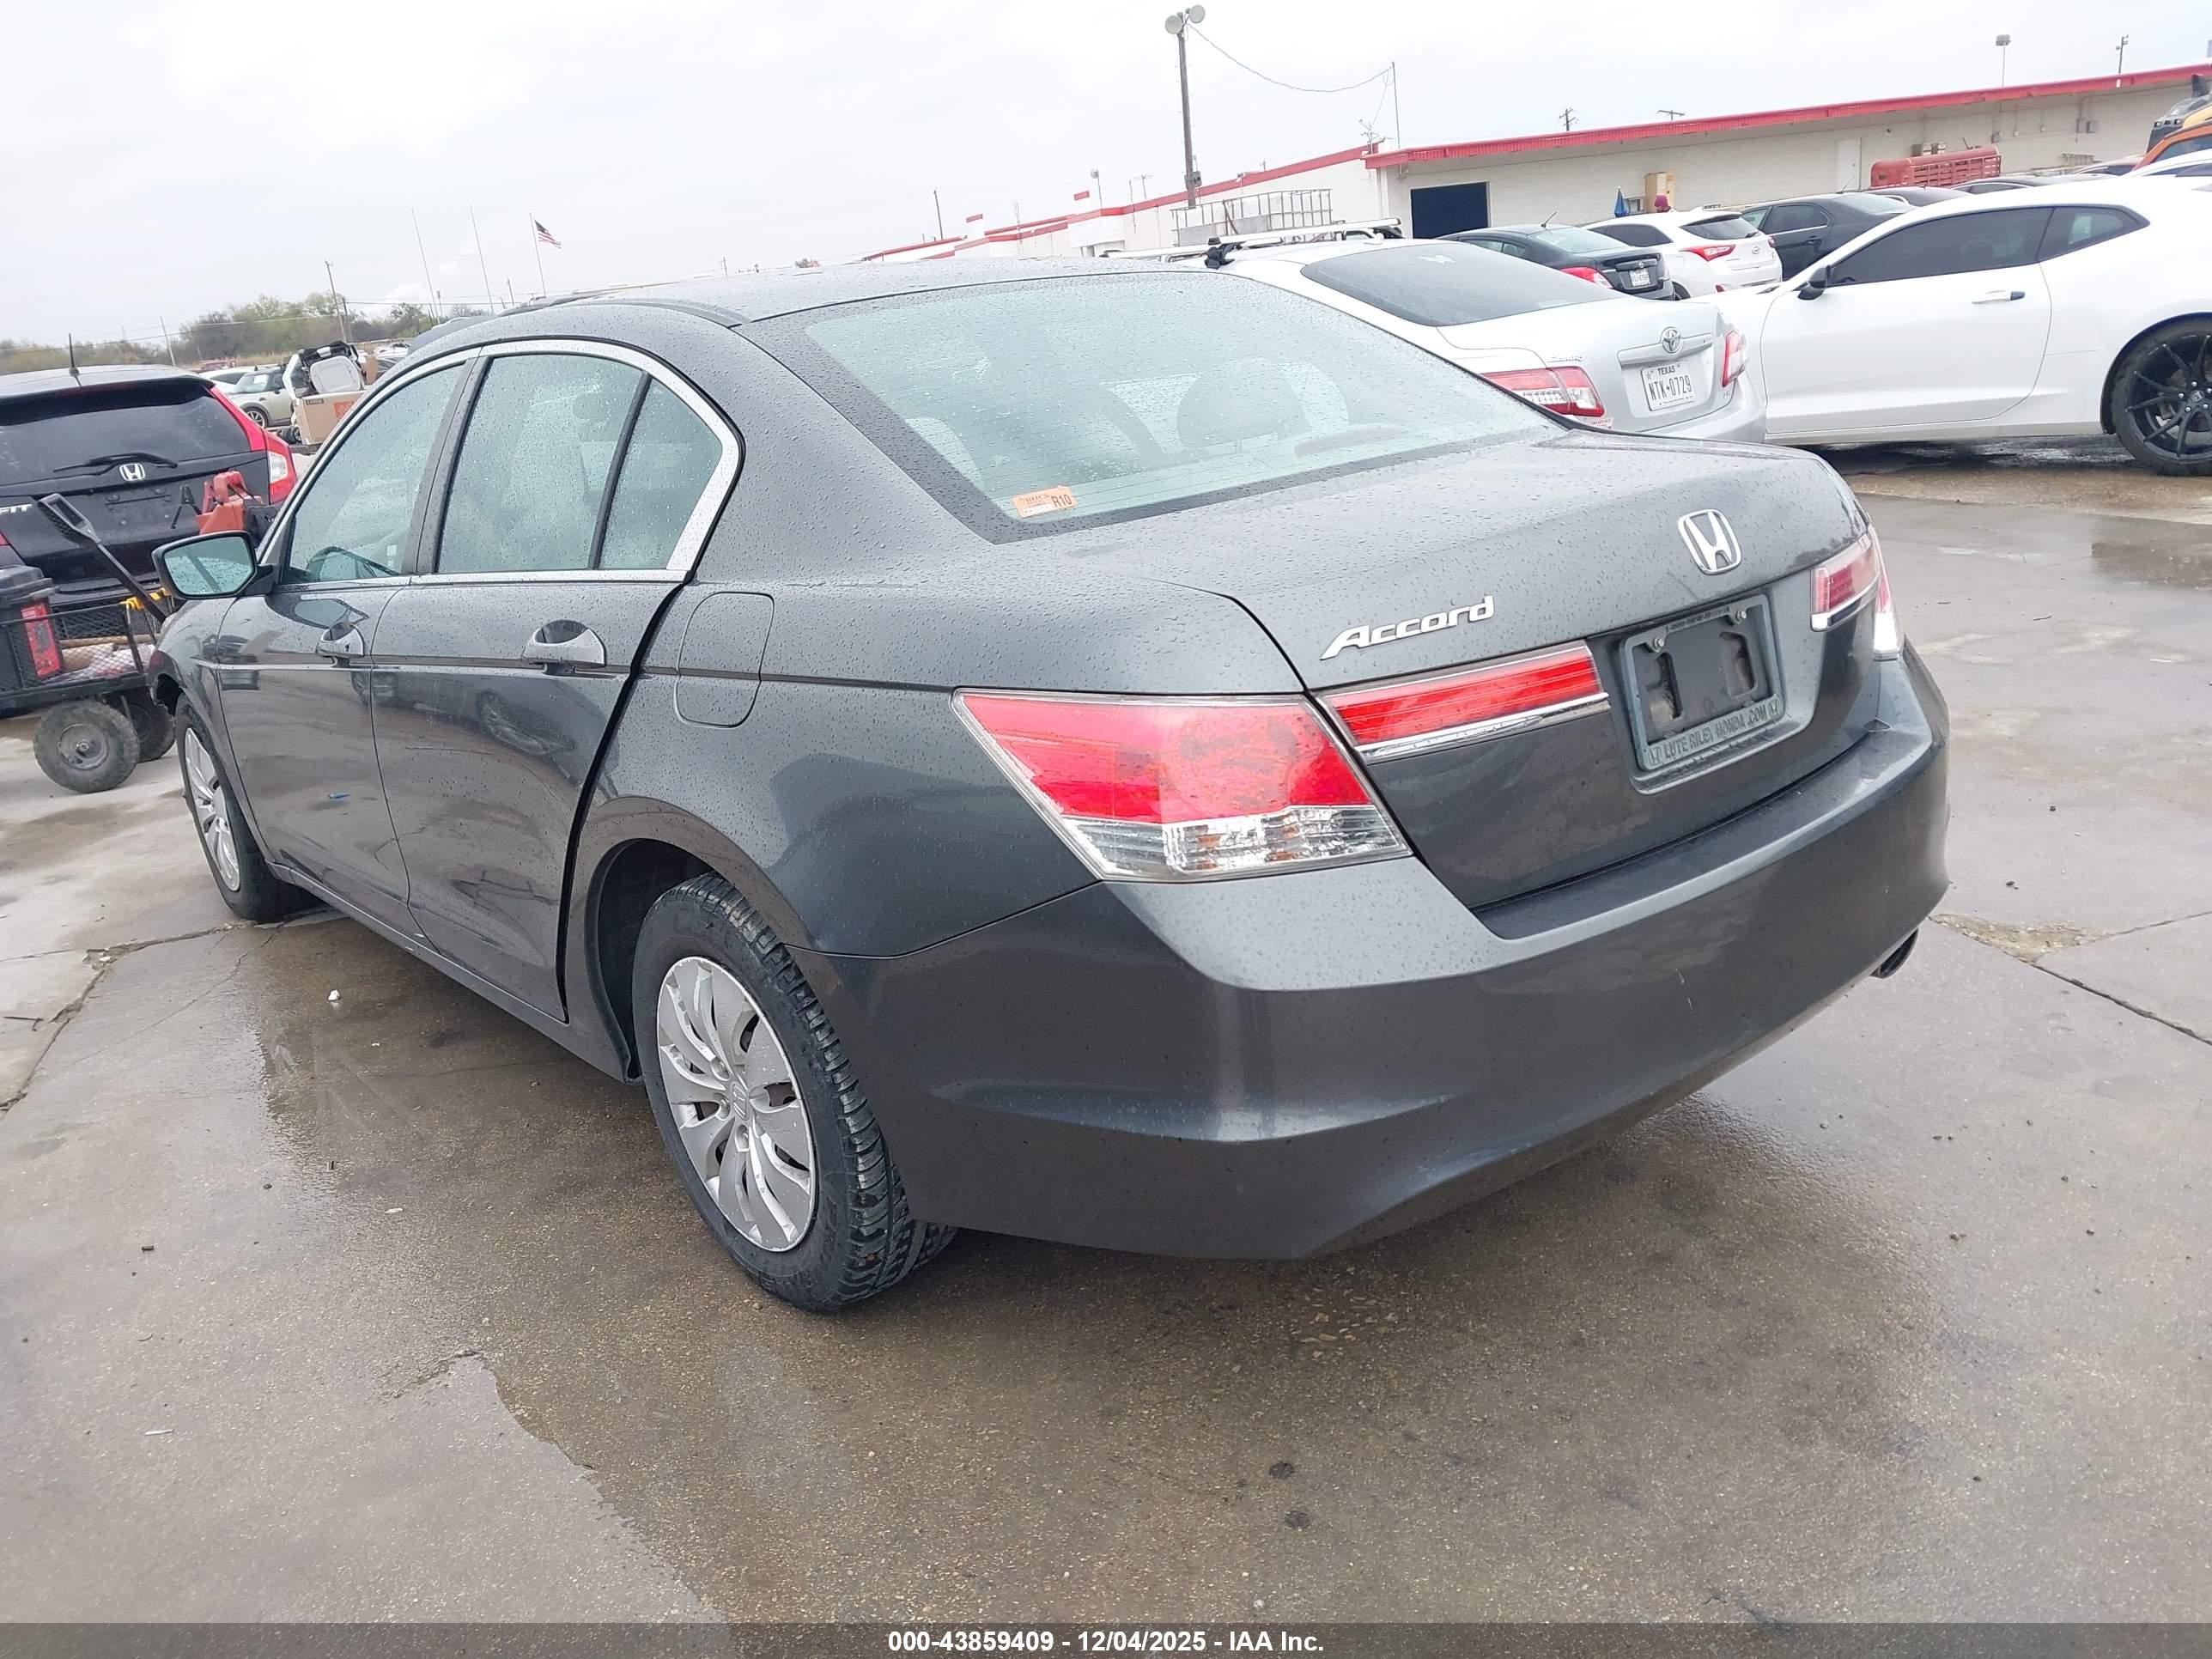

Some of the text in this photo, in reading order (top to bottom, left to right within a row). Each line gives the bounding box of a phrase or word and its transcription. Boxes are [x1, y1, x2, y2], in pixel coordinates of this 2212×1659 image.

[1657, 365, 1676, 376] TEXAS
[1051, 494, 1073, 507] R10
[1320, 595, 1494, 660] Accord
[1716, 714, 1747, 738] HONDA
